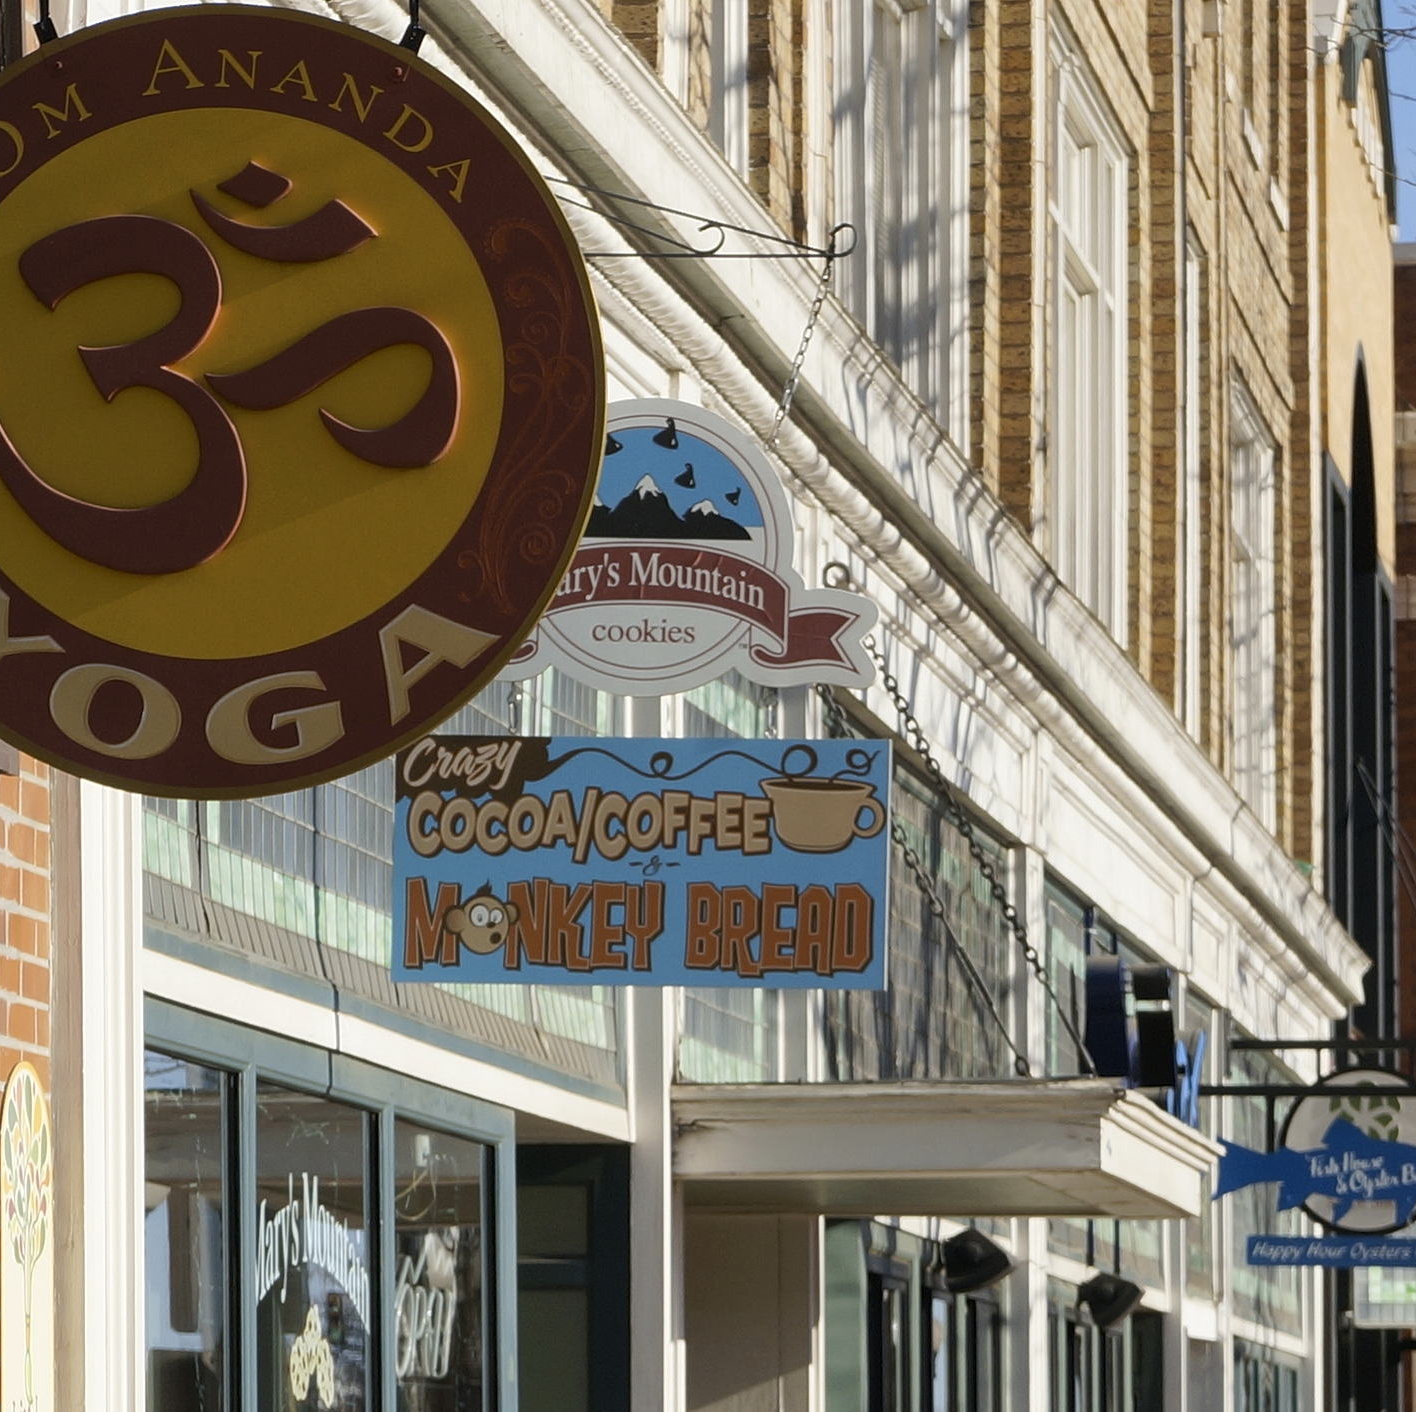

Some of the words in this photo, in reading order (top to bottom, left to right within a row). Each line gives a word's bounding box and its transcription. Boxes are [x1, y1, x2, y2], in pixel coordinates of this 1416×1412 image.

[142, 38, 472, 204] ANANDA
[556, 552, 620, 600] ary's
[628, 552, 766, 610] Mountain
[591, 618, 696, 643] cookies
[403, 737, 523, 790] Crazy
[407, 787, 774, 863] COCOA/COFFEE
[685, 881, 876, 977] BREAD
[1349, 1168, 1400, 1198] Oyster
[302, 1172, 371, 1336] Mountain
[1252, 1241, 1301, 1264] Happy
[1307, 1242, 1348, 1259] Hour
[1350, 1241, 1412, 1264] Oysters
